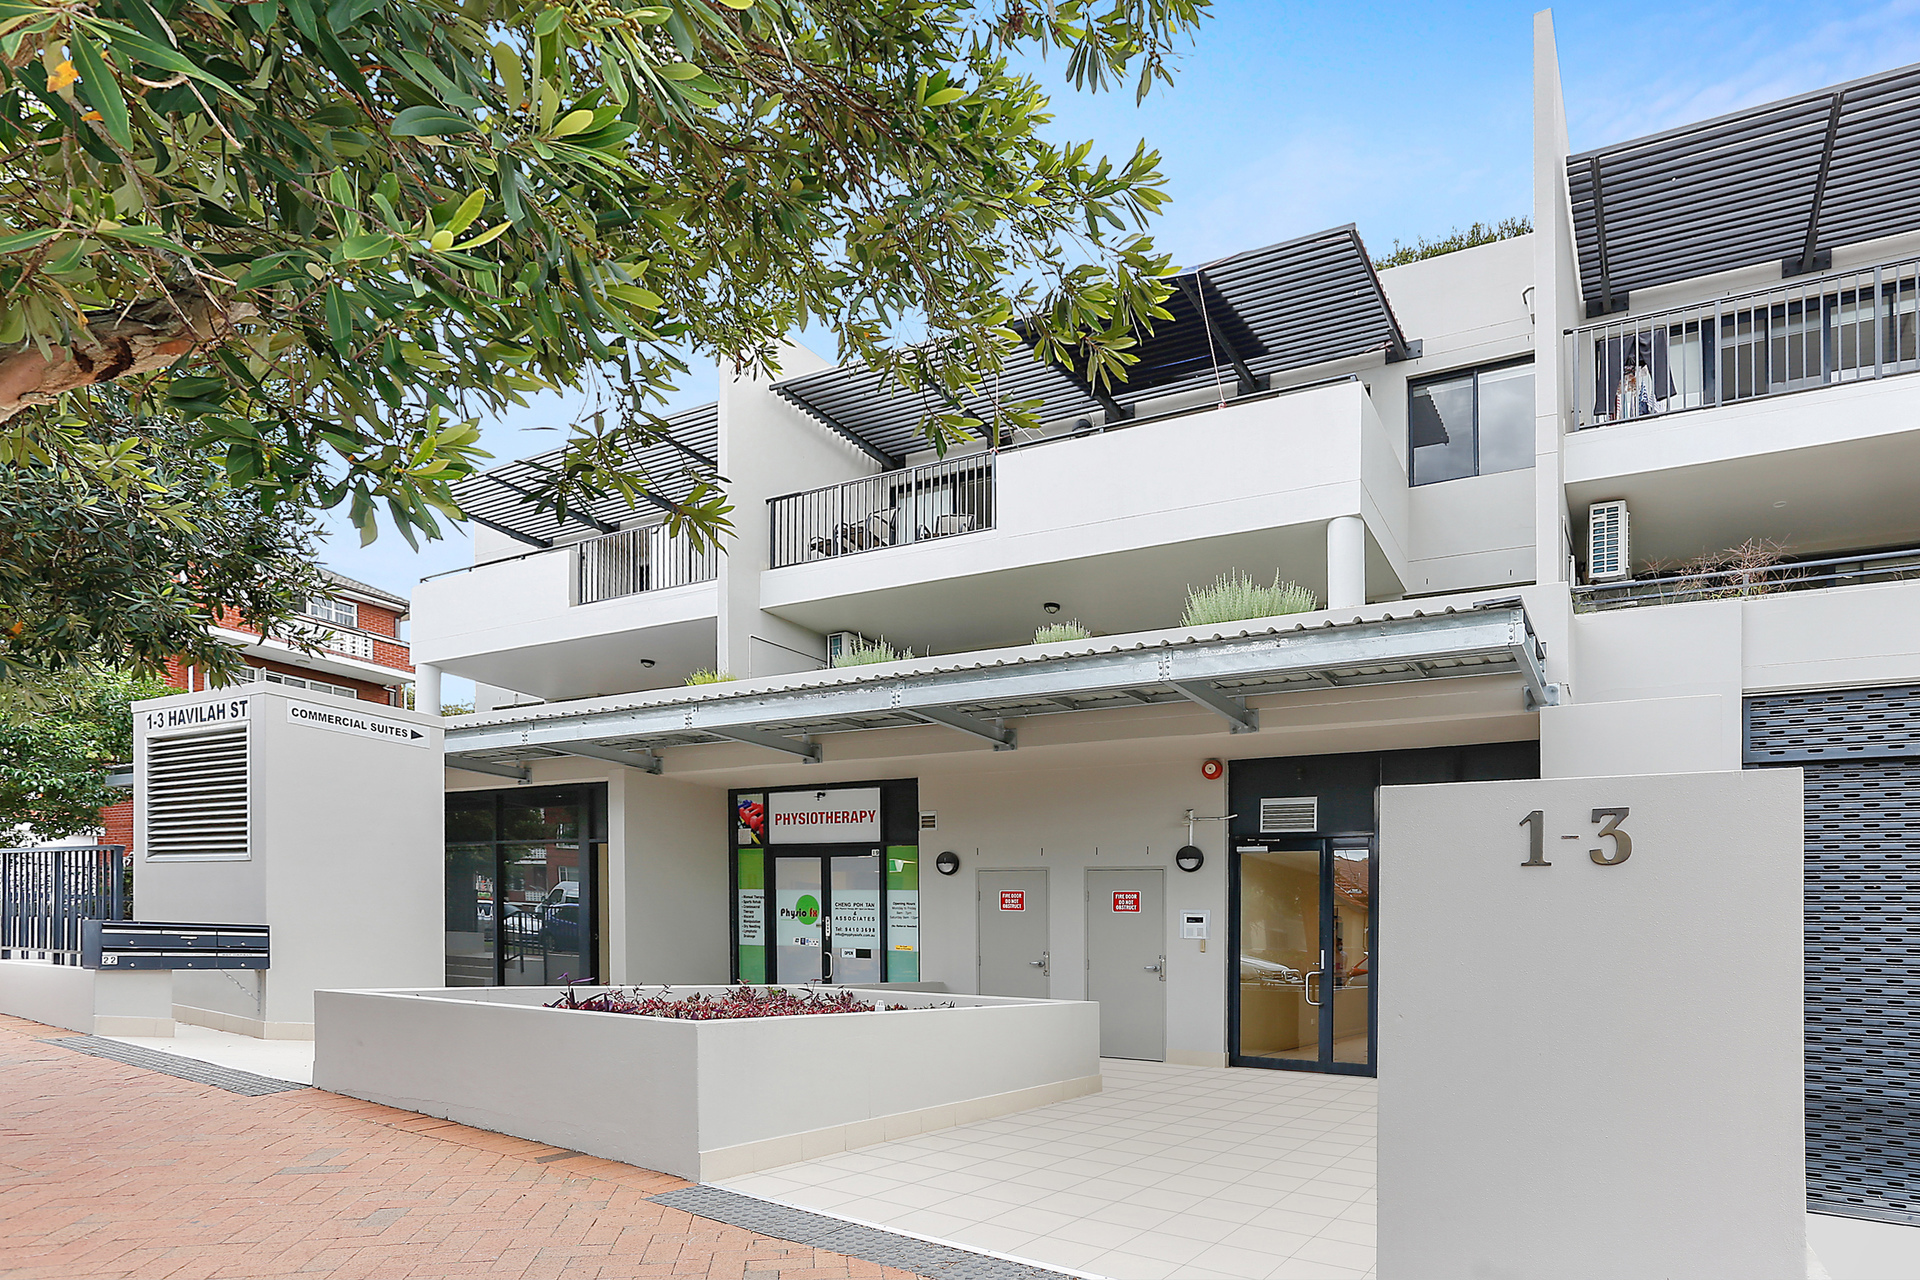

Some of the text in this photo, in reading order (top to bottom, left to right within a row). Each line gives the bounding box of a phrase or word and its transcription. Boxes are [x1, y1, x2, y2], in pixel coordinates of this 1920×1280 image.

[146, 700, 248, 730] 1-3 HAVILAH ST
[291, 708, 409, 739] COMMERCIAL SUITES
[775, 809, 877, 826] PHYSIOTHERAPY
[780, 907, 807, 919] Physio
[103, 956, 117, 965] 22
